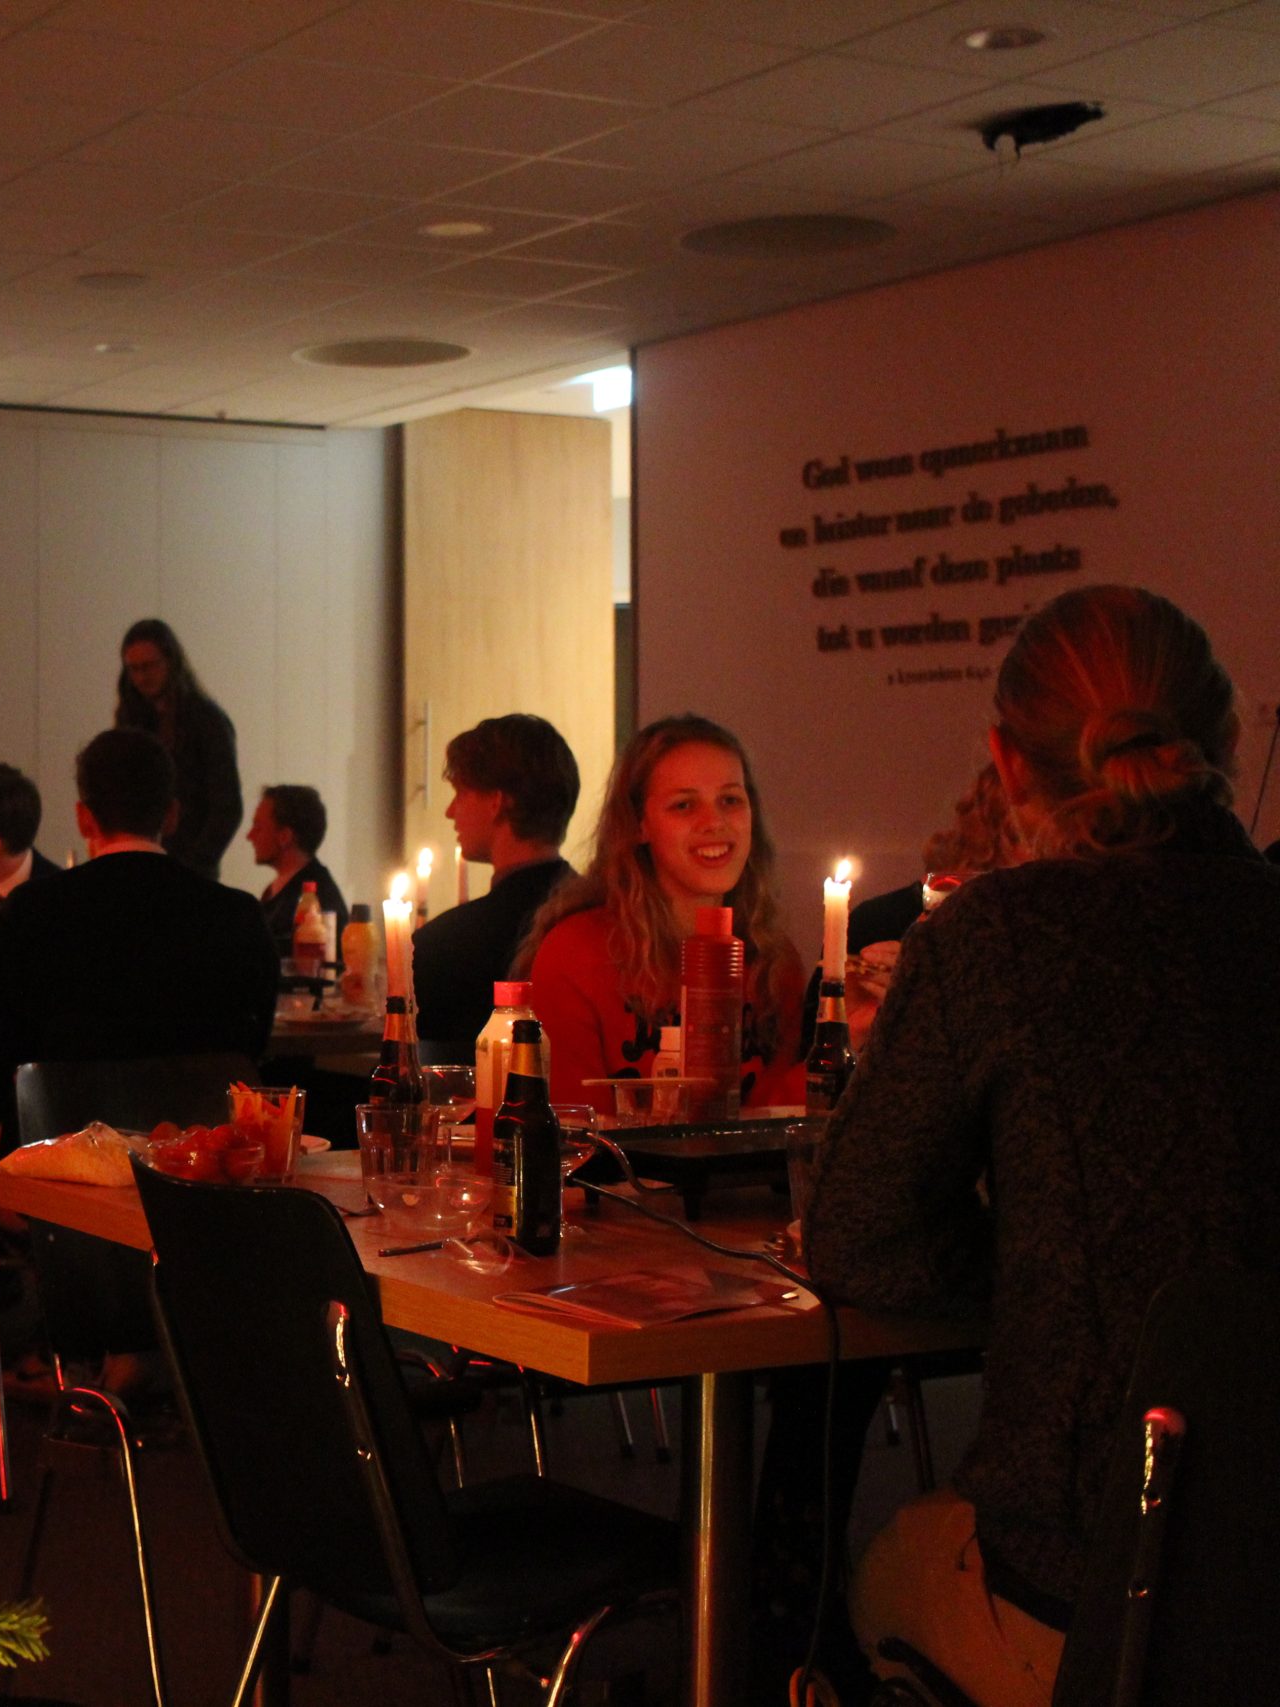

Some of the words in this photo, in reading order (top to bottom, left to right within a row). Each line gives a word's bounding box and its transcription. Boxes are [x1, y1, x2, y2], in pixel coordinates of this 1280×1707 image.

[803, 455, 850, 489] God
[919, 425, 1089, 478] opmerkzaam
[961, 491, 993, 524] de
[811, 567, 850, 598] die
[995, 543, 1082, 586] plaats
[856, 628, 874, 649] u
[880, 612, 971, 647] worden
